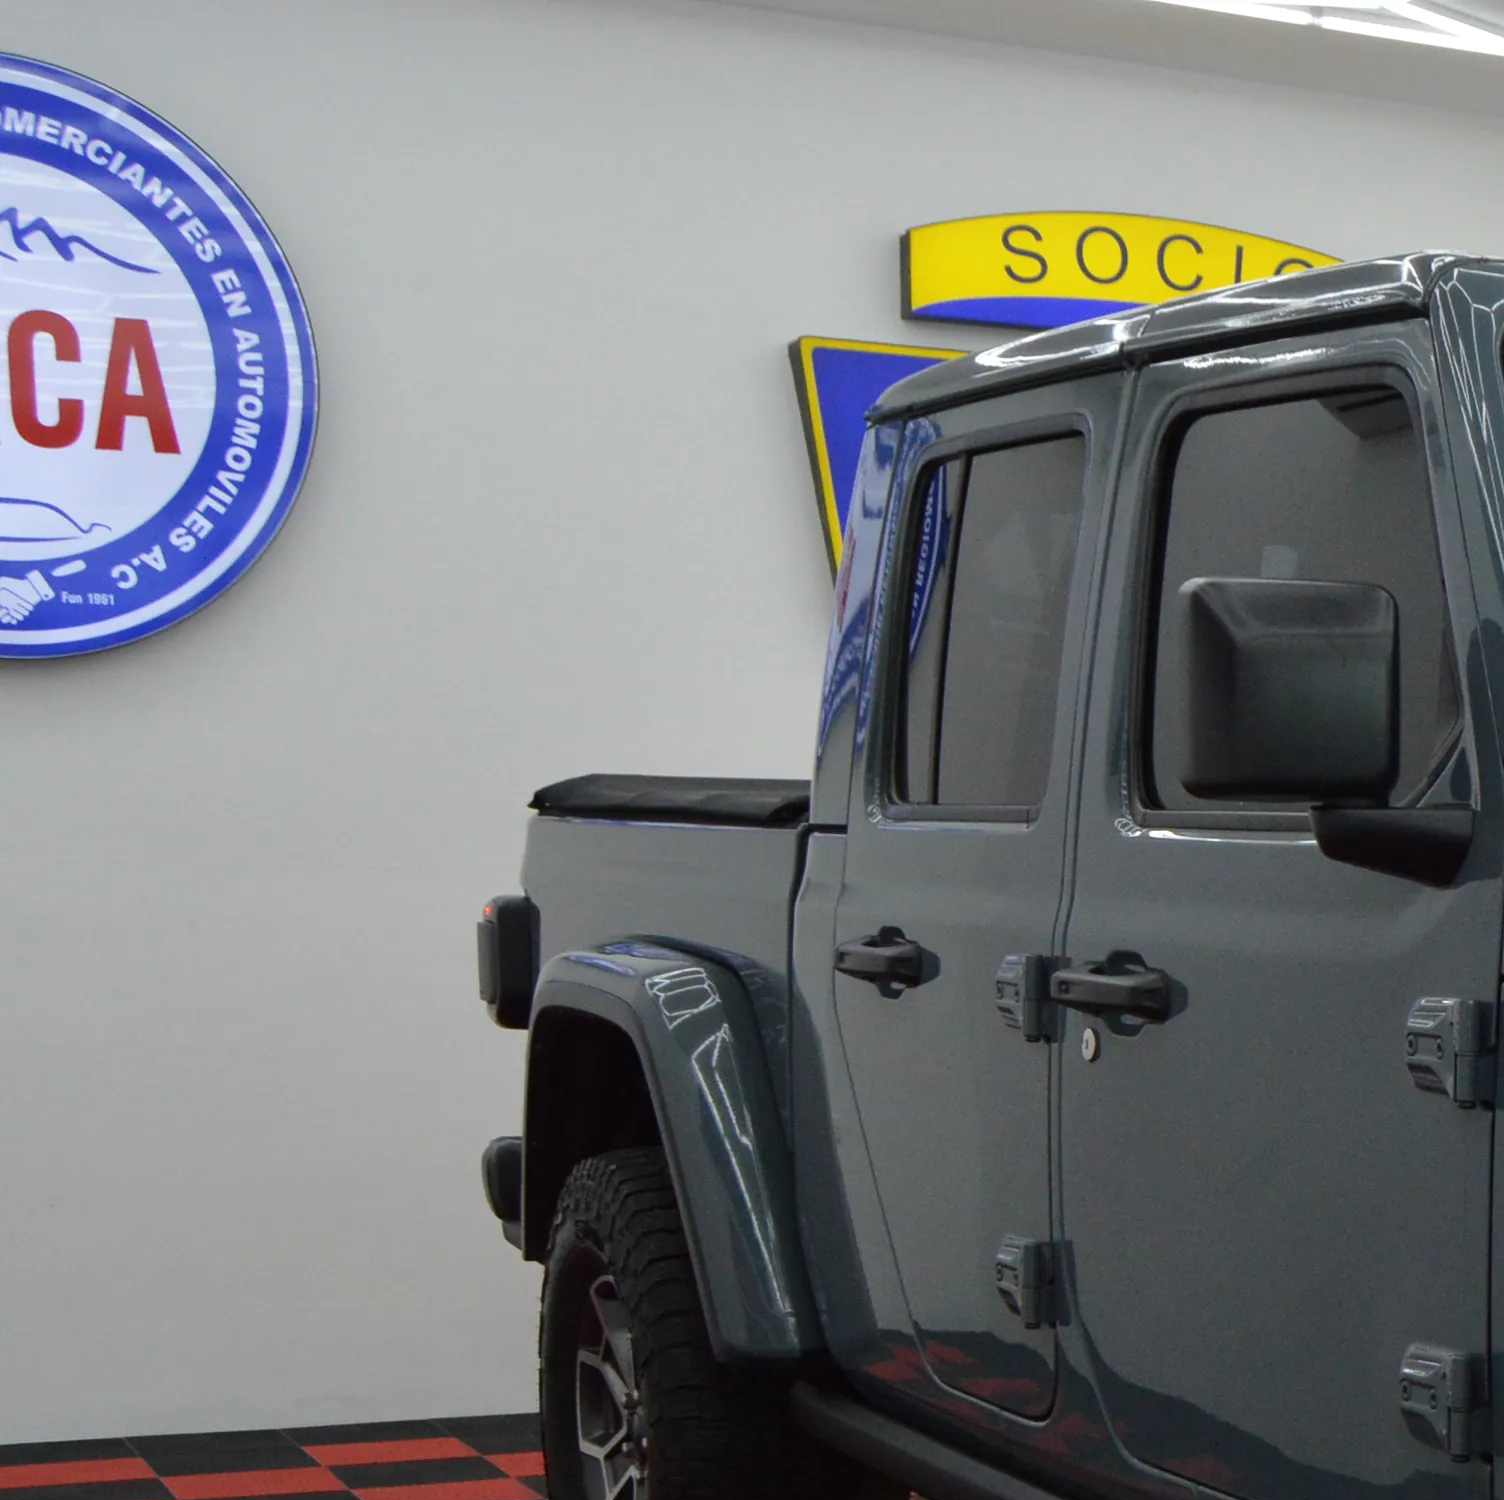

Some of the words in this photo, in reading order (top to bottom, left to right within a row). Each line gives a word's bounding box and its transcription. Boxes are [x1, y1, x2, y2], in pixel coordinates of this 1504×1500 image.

[0, 106, 222, 263] MERCIANTES
[211, 270, 252, 318] EN
[1001, 224, 1315, 292] SOCI
[0, 309, 181, 455] CA
[169, 327, 265, 553] AUTOMOVILES
[62, 591, 83, 605] Fun
